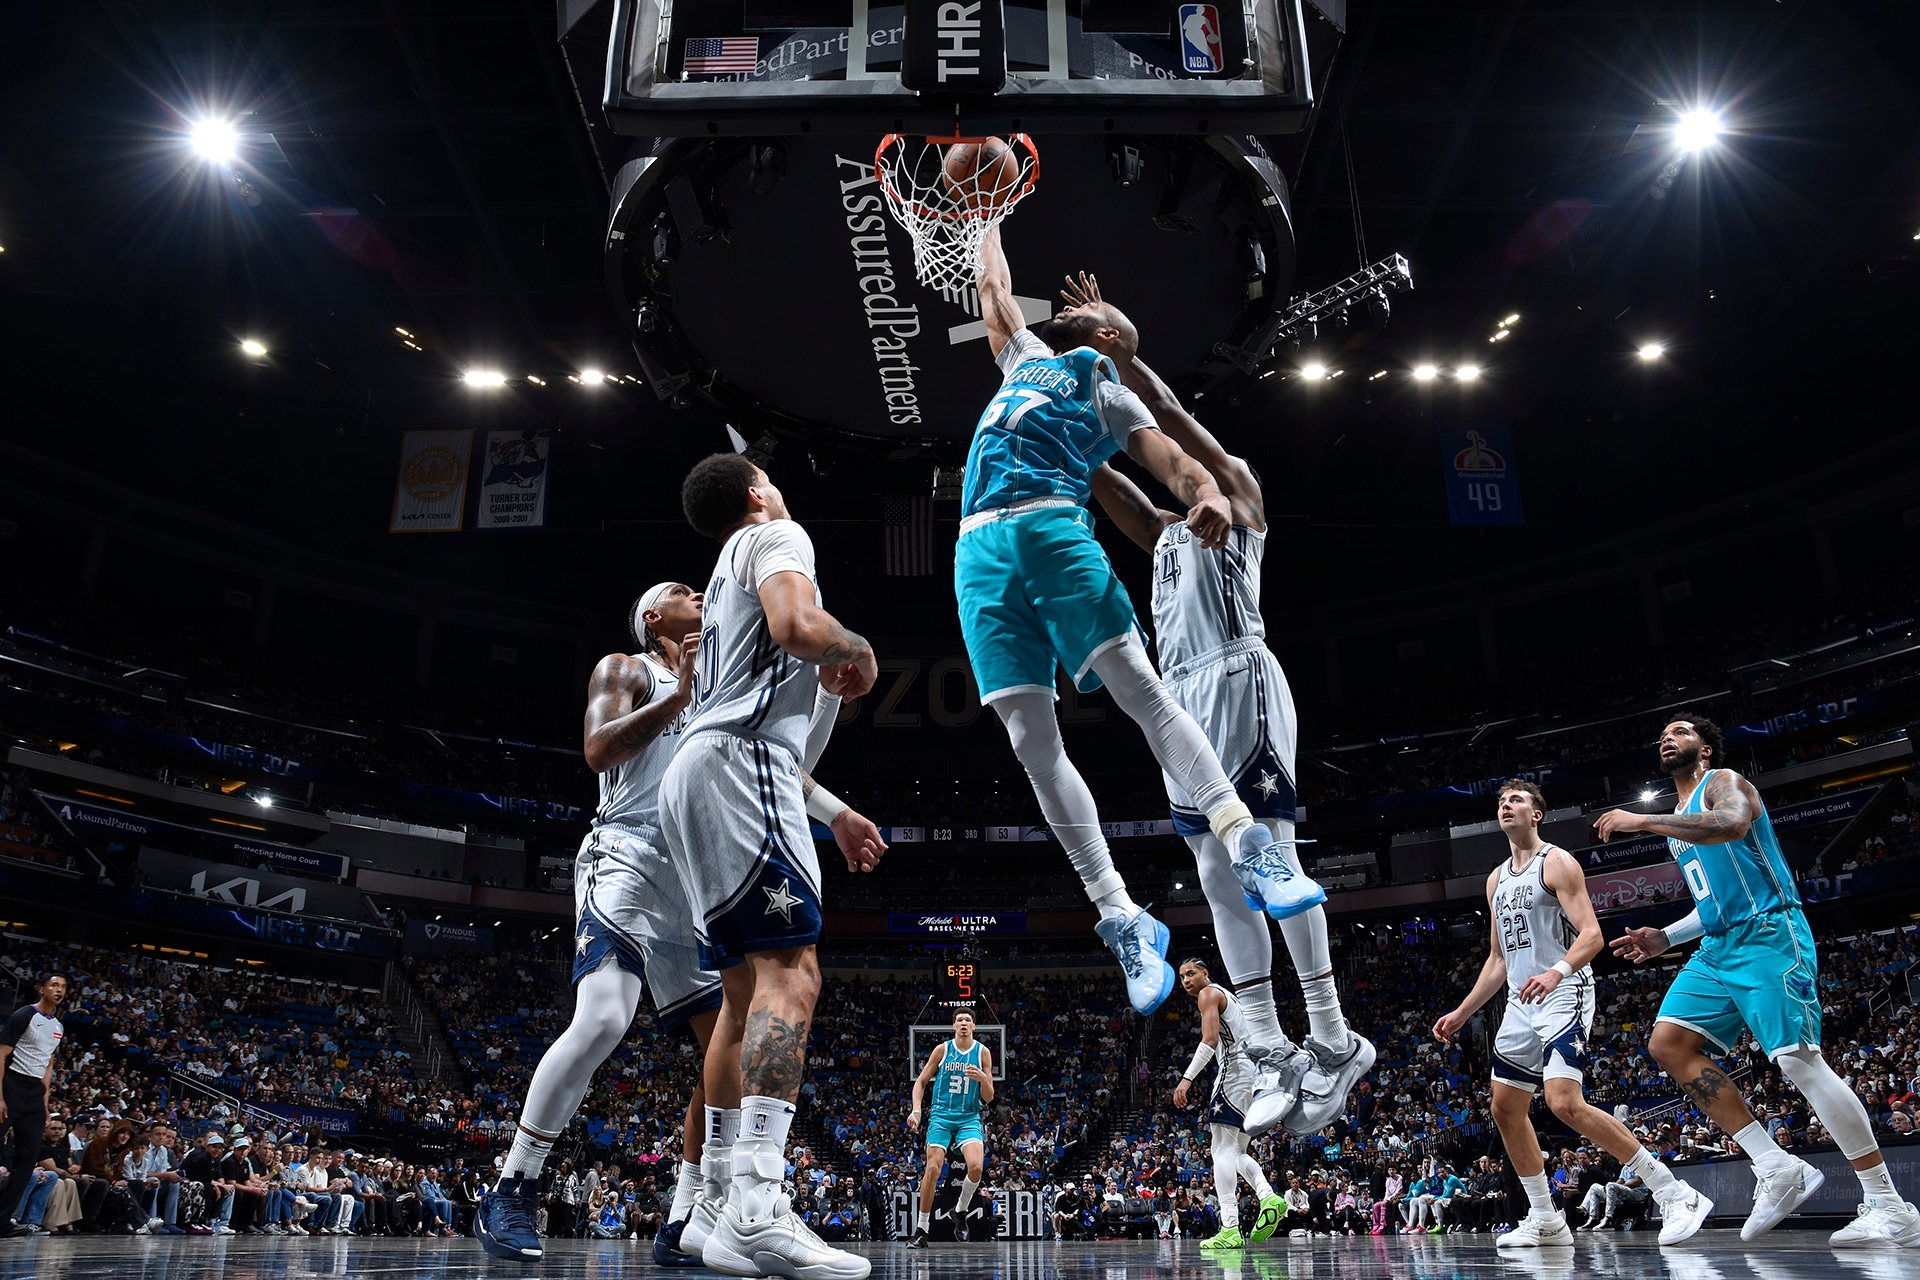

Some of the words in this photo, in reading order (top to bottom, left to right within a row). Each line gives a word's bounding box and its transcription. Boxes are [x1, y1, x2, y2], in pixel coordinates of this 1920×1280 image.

[1189, 56, 1209, 68] NBA
[835, 153, 922, 425] AssuredPartners
[489, 494, 520, 503] TURNER
[521, 493, 537, 502] CUP
[1467, 482, 1502, 511] 49
[489, 503, 535, 514] CHAMPIONS
[493, 515, 529, 523] 2000-2001
[1800, 806, 1825, 818] Home
[1826, 801, 1852, 812] Court
[74, 810, 147, 834] AssuredPartners
[1148, 822, 1154, 834] 4
[903, 828, 913, 840] 53
[933, 828, 952, 841] 6:23
[965, 829, 978, 839] 3RD
[998, 828, 1009, 840] 53
[1115, 824, 1121, 836] 2
[275, 851, 298, 862] Home
[298, 855, 320, 866] Court
[1683, 858, 1711, 902] 0
[189, 869, 307, 914] KIA
[917, 916, 954, 926] Michelob
[961, 915, 998, 925] ULTRA
[442, 927, 477, 937] FANDUEL
[1503, 912, 1531, 952] 22
[947, 964, 973, 976] 6:23
[958, 976, 971, 997] 5
[948, 1074, 970, 1095] 31
